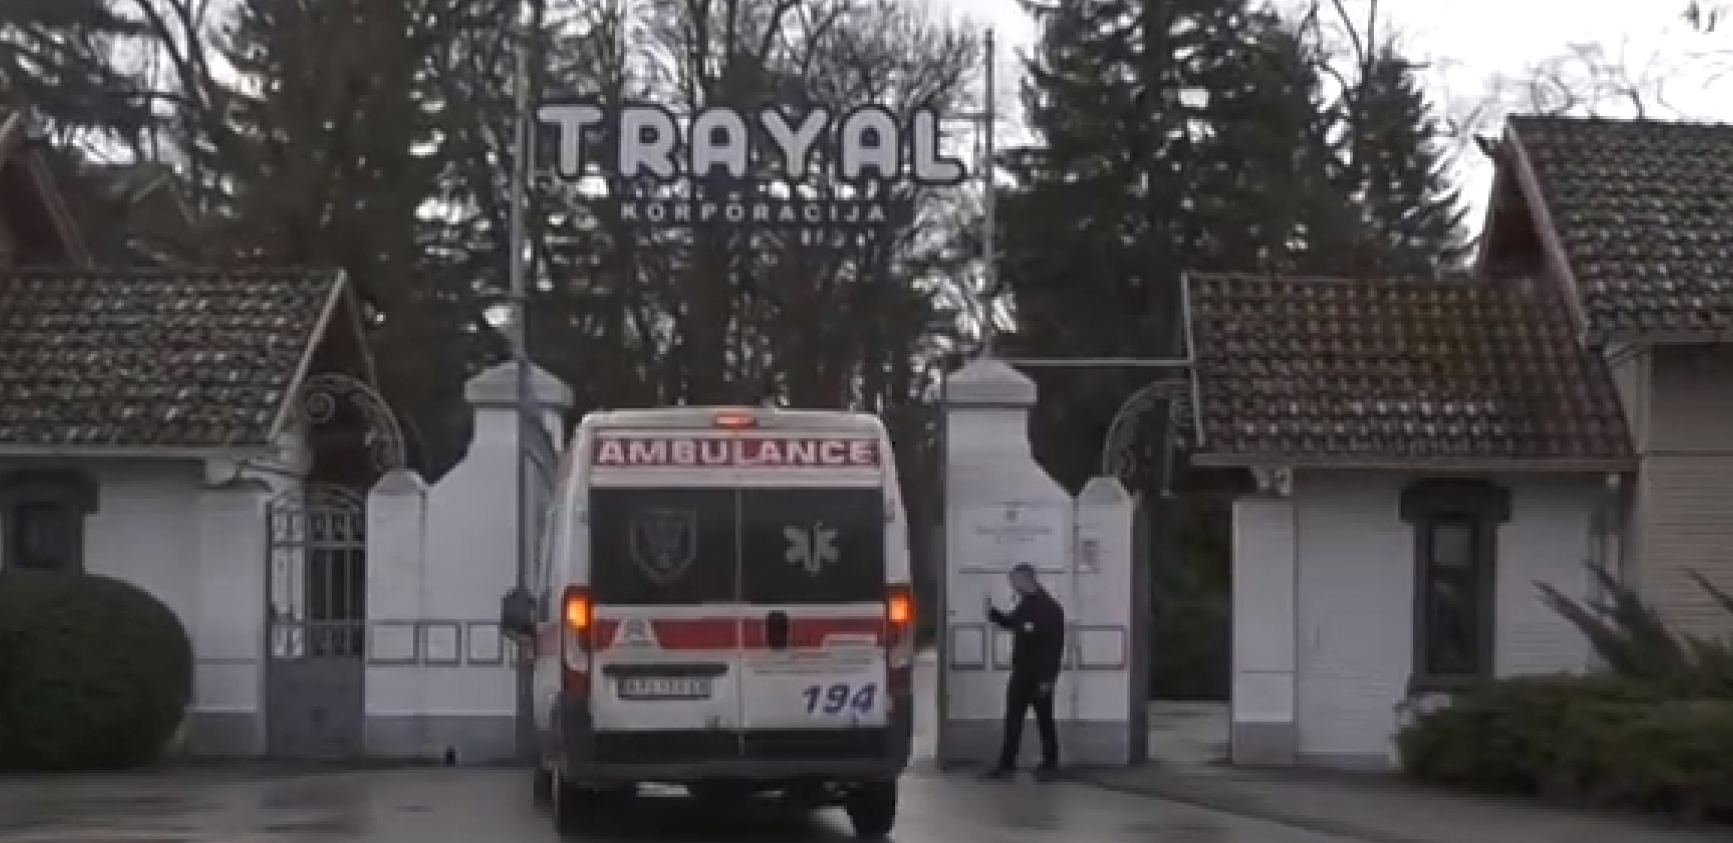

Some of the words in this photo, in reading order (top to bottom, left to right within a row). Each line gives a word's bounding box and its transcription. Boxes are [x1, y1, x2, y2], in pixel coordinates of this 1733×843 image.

[537, 104, 965, 182] TRAYAL
[620, 202, 886, 222] KORPORACIJA
[599, 440, 874, 464] AMBULANCE
[802, 682, 878, 714] 194
